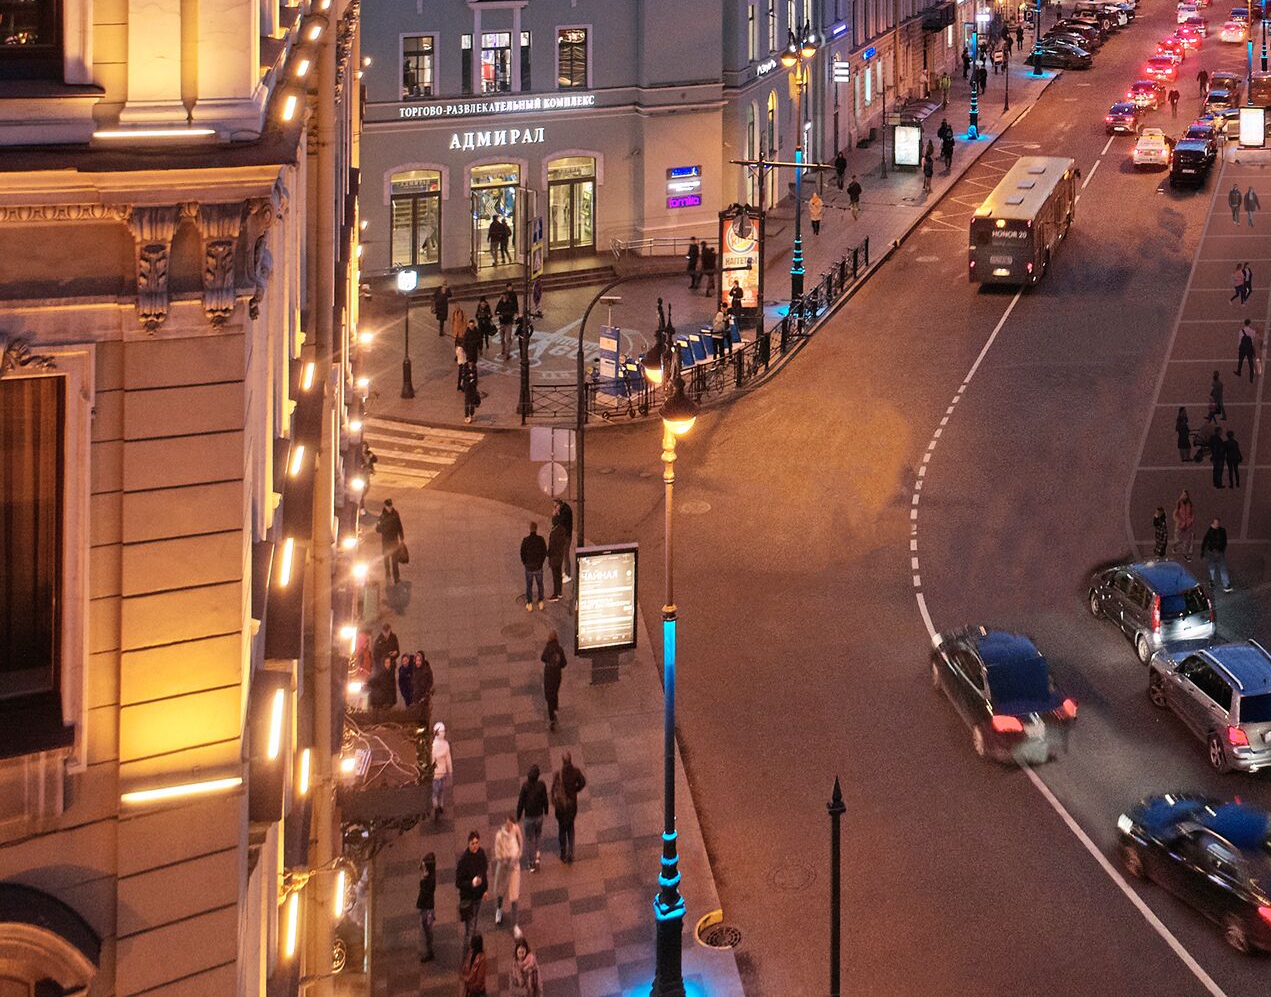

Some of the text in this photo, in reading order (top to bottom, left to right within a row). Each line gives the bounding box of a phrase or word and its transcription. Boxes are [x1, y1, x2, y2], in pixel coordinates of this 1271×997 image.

[400, 95, 595, 118] ТОРГОВО-РАЗВЛЕКАТЕЛЬНЫЙ КОМПЛЕКС
[449, 127, 545, 151] АДМИРАЛ
[992, 230, 1017, 238] HONOR
[725, 256, 758, 266] НАГГЕТЫ
[581, 569, 618, 580] ЧАЙНАЯ
